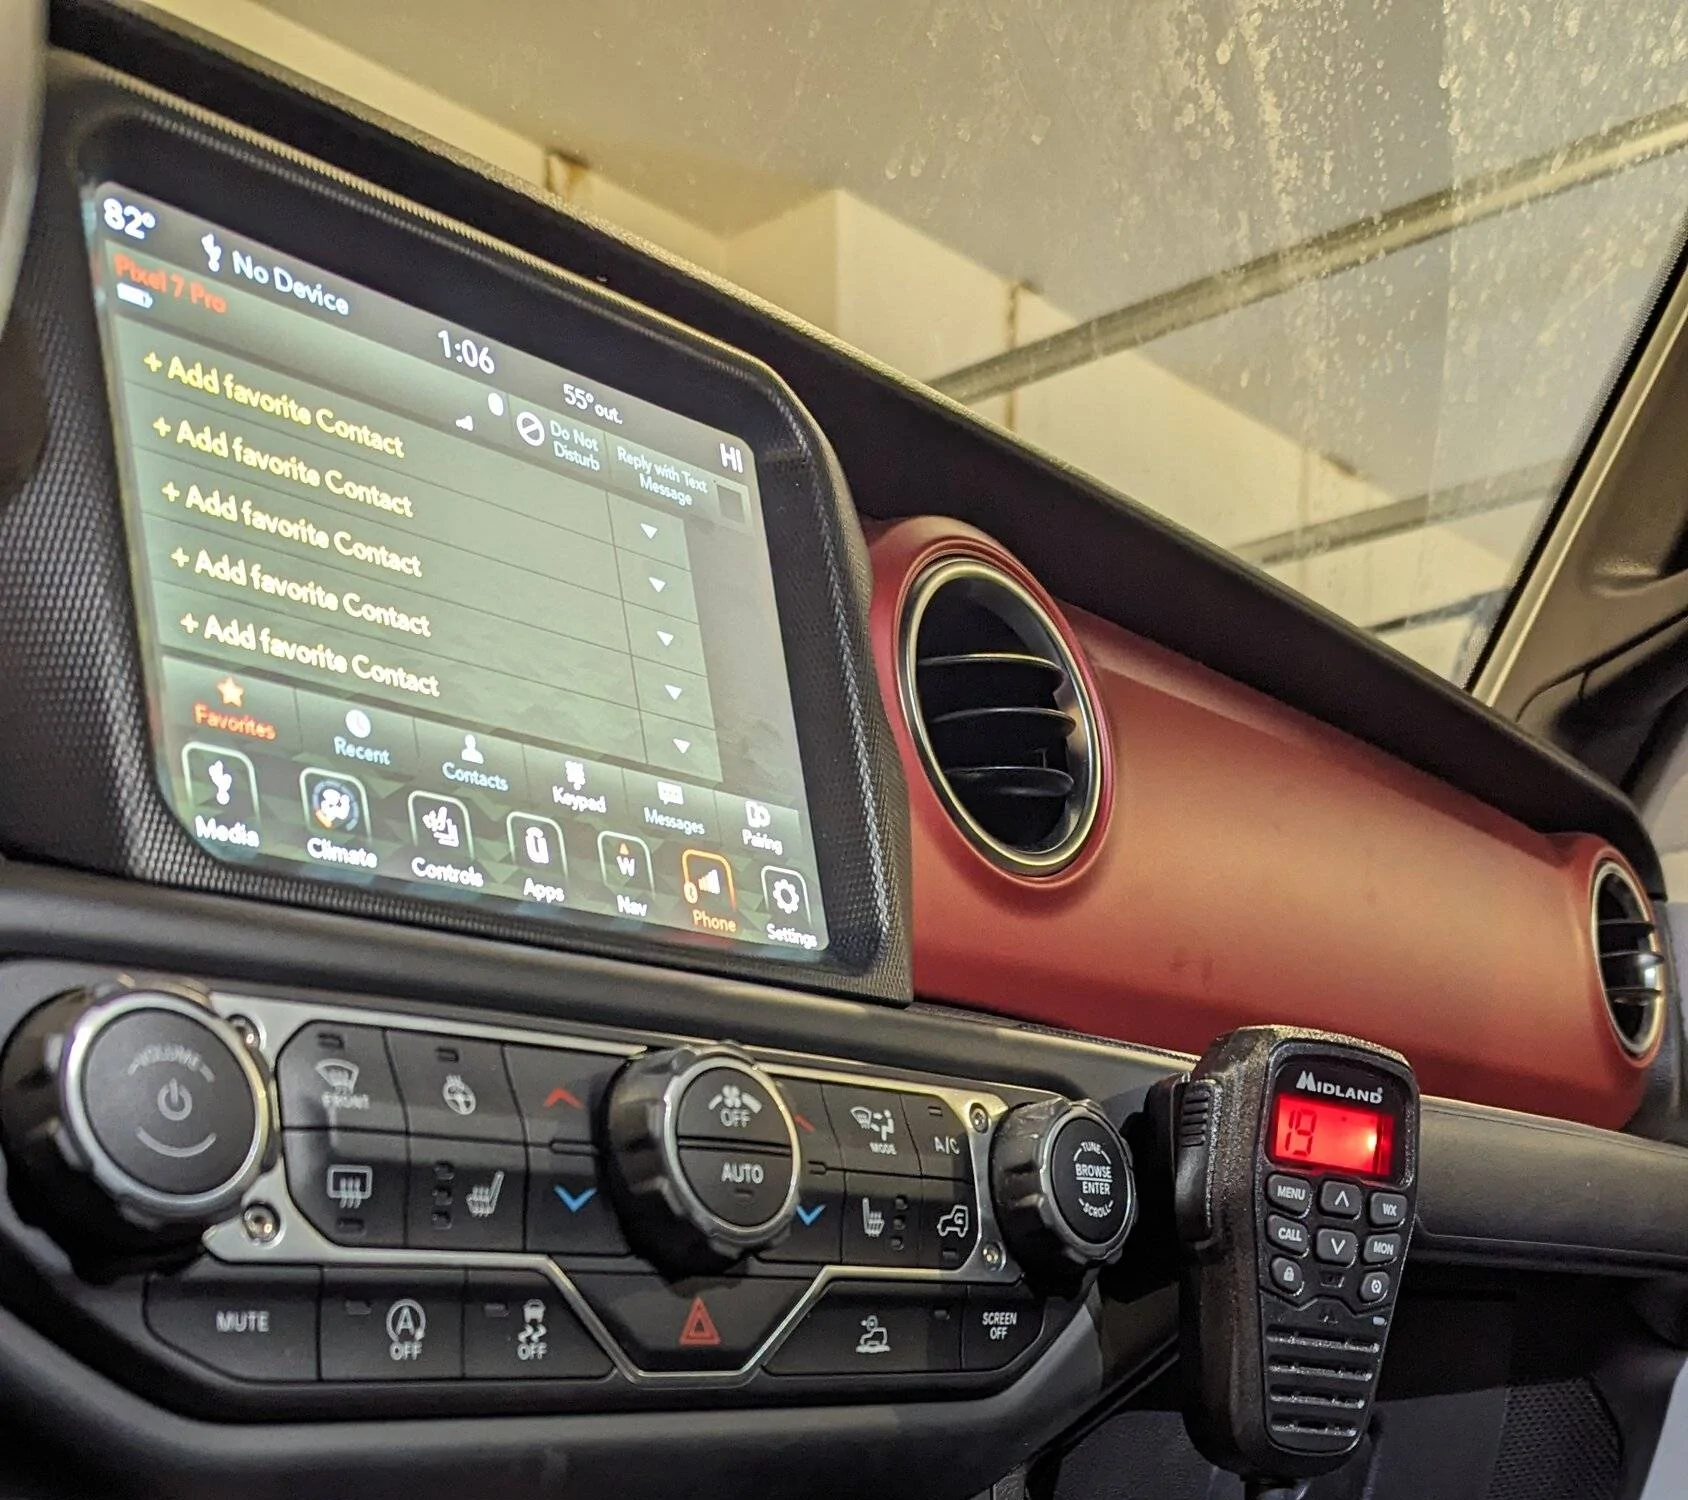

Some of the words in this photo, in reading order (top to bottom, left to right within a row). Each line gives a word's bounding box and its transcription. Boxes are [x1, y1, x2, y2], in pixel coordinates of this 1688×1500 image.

[113, 253, 167, 293] Pixel
[172, 276, 184, 298] 7
[190, 282, 227, 313] Pro
[232, 250, 269, 285] No
[274, 267, 349, 316] Device
[437, 330, 495, 375] 1:06
[168, 356, 219, 395] Add
[224, 373, 311, 426] favorite
[316, 409, 405, 458] Contact
[595, 403, 623, 425] out.
[550, 420, 571, 441] Do
[574, 431, 599, 452] Not
[176, 420, 229, 457] Add
[232, 438, 320, 487] favorite
[325, 470, 413, 518] Contact
[554, 441, 600, 472] Disturb
[616, 447, 652, 474] Reply
[654, 462, 680, 484] with
[681, 471, 708, 493] Text
[719, 443, 744, 473] HI
[639, 473, 693, 507] Message
[185, 485, 237, 522] Add
[241, 500, 329, 549] favorite
[334, 531, 423, 577] Contact
[194, 550, 247, 586] Add
[250, 564, 338, 611] favorite
[343, 593, 432, 637] Contact
[204, 615, 256, 650] Add
[260, 624, 347, 673] favorite
[352, 655, 441, 697] Contact
[193, 703, 276, 740] Favorites
[333, 736, 391, 765] Recent
[442, 761, 509, 792] Contacts
[552, 786, 607, 814] Keypad
[194, 815, 260, 848] Media
[644, 807, 705, 835] Messages
[307, 838, 378, 869] Climate
[741, 829, 783, 856] Pairing
[411, 857, 484, 888] Controls
[616, 856, 636, 877] W
[523, 877, 565, 903] Apps
[617, 894, 648, 917] Nav
[693, 909, 737, 933] Phone
[766, 923, 818, 950] Settings
[1296, 1070, 1383, 1104] MIDLAND
[720, 1109, 751, 1128] OFF
[934, 1137, 960, 1155] A/C
[1284, 1108, 1318, 1157] 19
[1080, 1141, 1102, 1155] TUNE
[721, 1162, 764, 1184] AUTO
[1075, 1163, 1112, 1179] BROWSE
[1082, 1181, 1111, 1195] ENTER
[1277, 1185, 1306, 1200] MENU
[1082, 1202, 1112, 1218] SCROLL
[1382, 1203, 1397, 1217] WX
[1278, 1227, 1302, 1242] CALL
[1373, 1241, 1394, 1256] MON
[216, 1310, 270, 1333] MUTE
[982, 1311, 1017, 1326] SCREEN
[990, 1326, 1008, 1341] OFF
[389, 1342, 422, 1361] OFF
[517, 1342, 548, 1361] OFF
